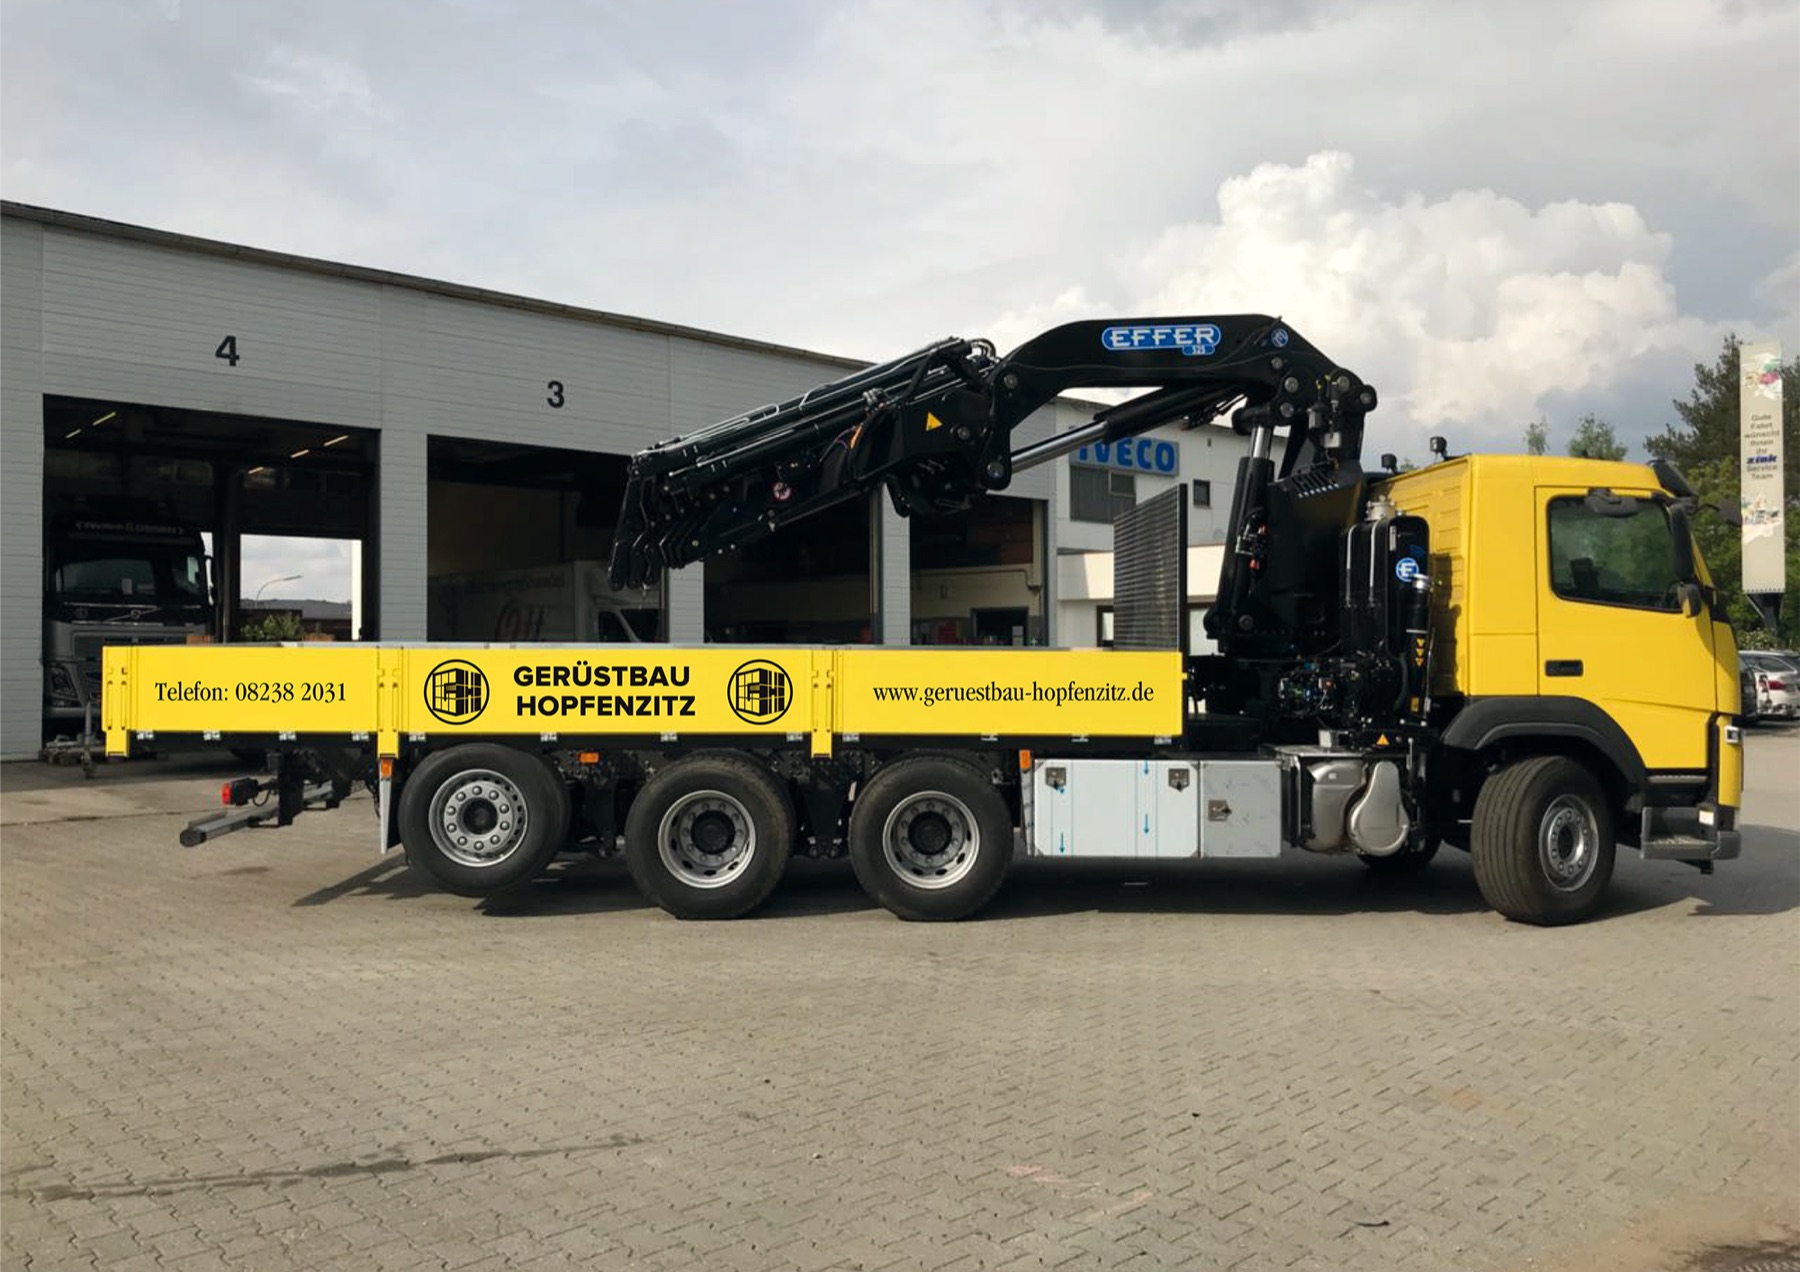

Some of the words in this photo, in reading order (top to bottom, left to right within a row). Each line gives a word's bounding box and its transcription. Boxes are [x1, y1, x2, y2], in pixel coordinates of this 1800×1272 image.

[1110, 327, 1215, 347] EFFER
[215, 336, 240, 366] 4
[547, 380, 565, 408] 3
[514, 660, 690, 687] GERÜSTBAU
[154, 681, 228, 702] Telefon:
[235, 682, 295, 704] 08238
[301, 682, 345, 704] 2031
[516, 695, 696, 717] HOPFENZITZ
[873, 680, 1154, 707] www.geruestbau-hopfenzitz.de
